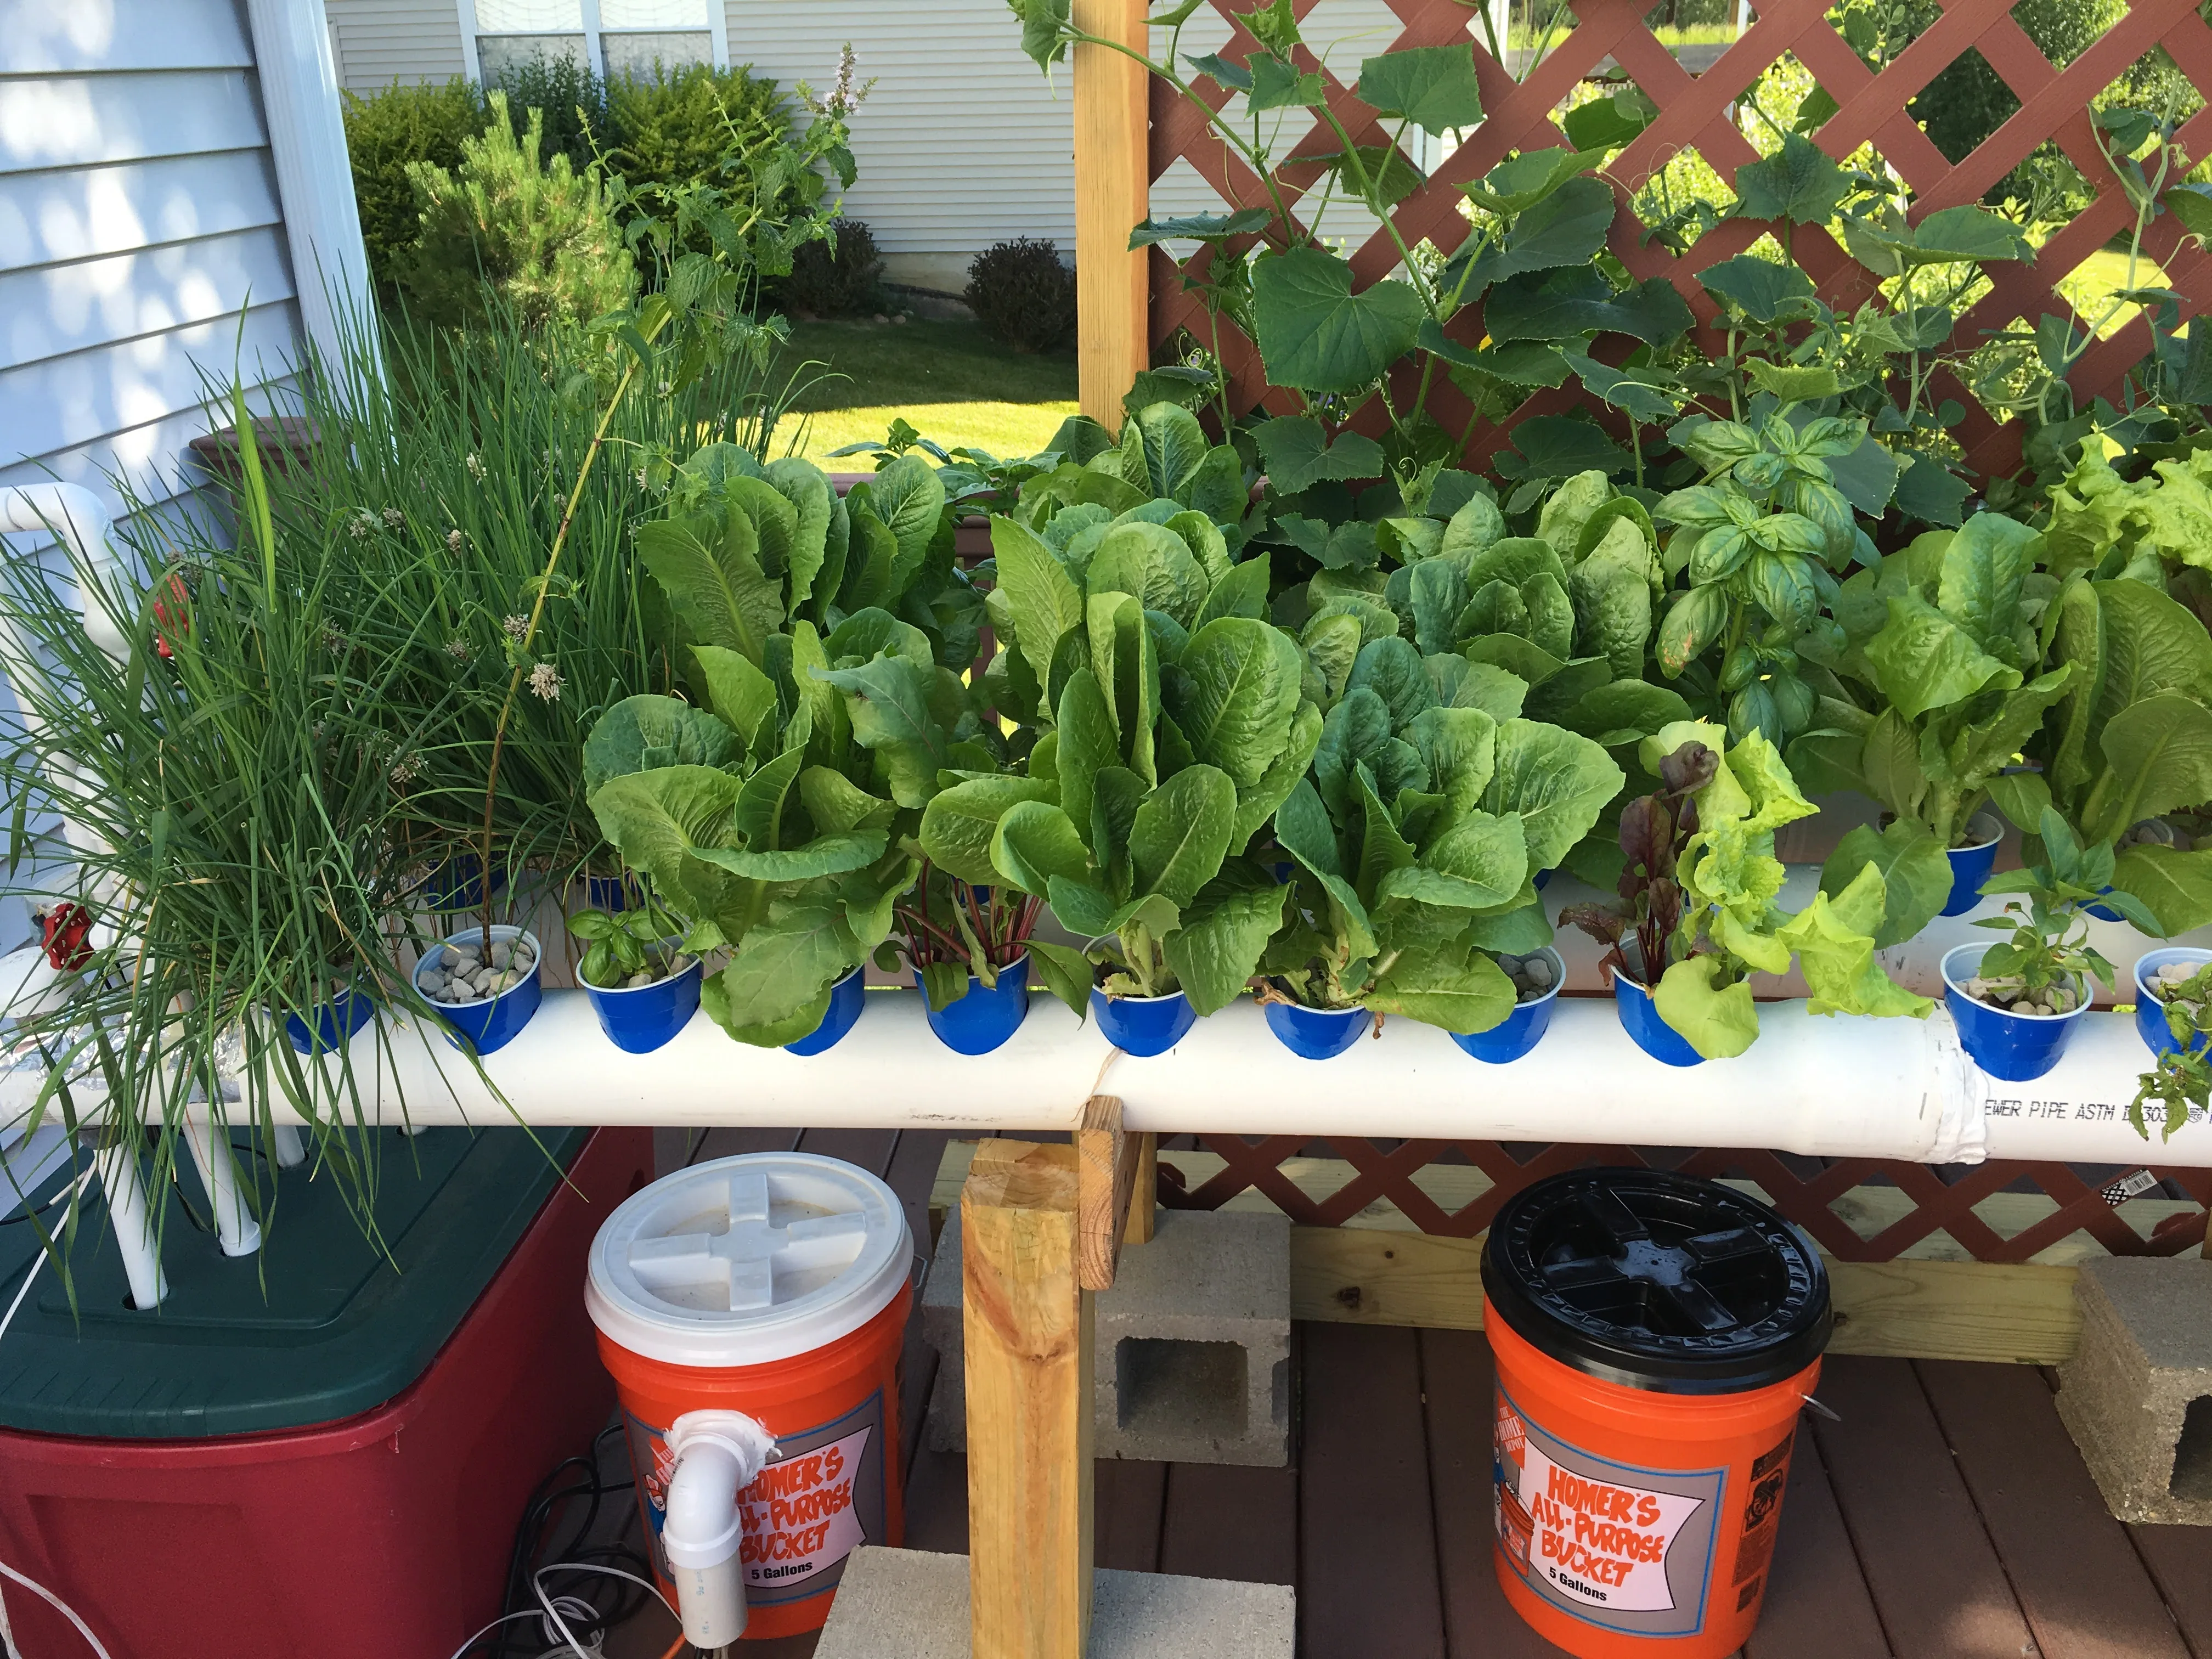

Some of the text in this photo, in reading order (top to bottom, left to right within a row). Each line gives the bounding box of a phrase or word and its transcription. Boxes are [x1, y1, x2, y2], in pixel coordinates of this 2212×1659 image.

[2029, 1101, 2068, 1119] PIPE
[2075, 1103, 2115, 1121] ASTM
[1548, 1465, 1661, 1527] HOMER'S
[740, 1520, 831, 1565] BUCKET
[1532, 1492, 1665, 1563] ALL-PURPOSE
[751, 1562, 813, 1579] 5 Gallons
[1542, 1529, 1634, 1588] BUCKET
[1549, 1566, 1607, 1601] 5 Gallons
